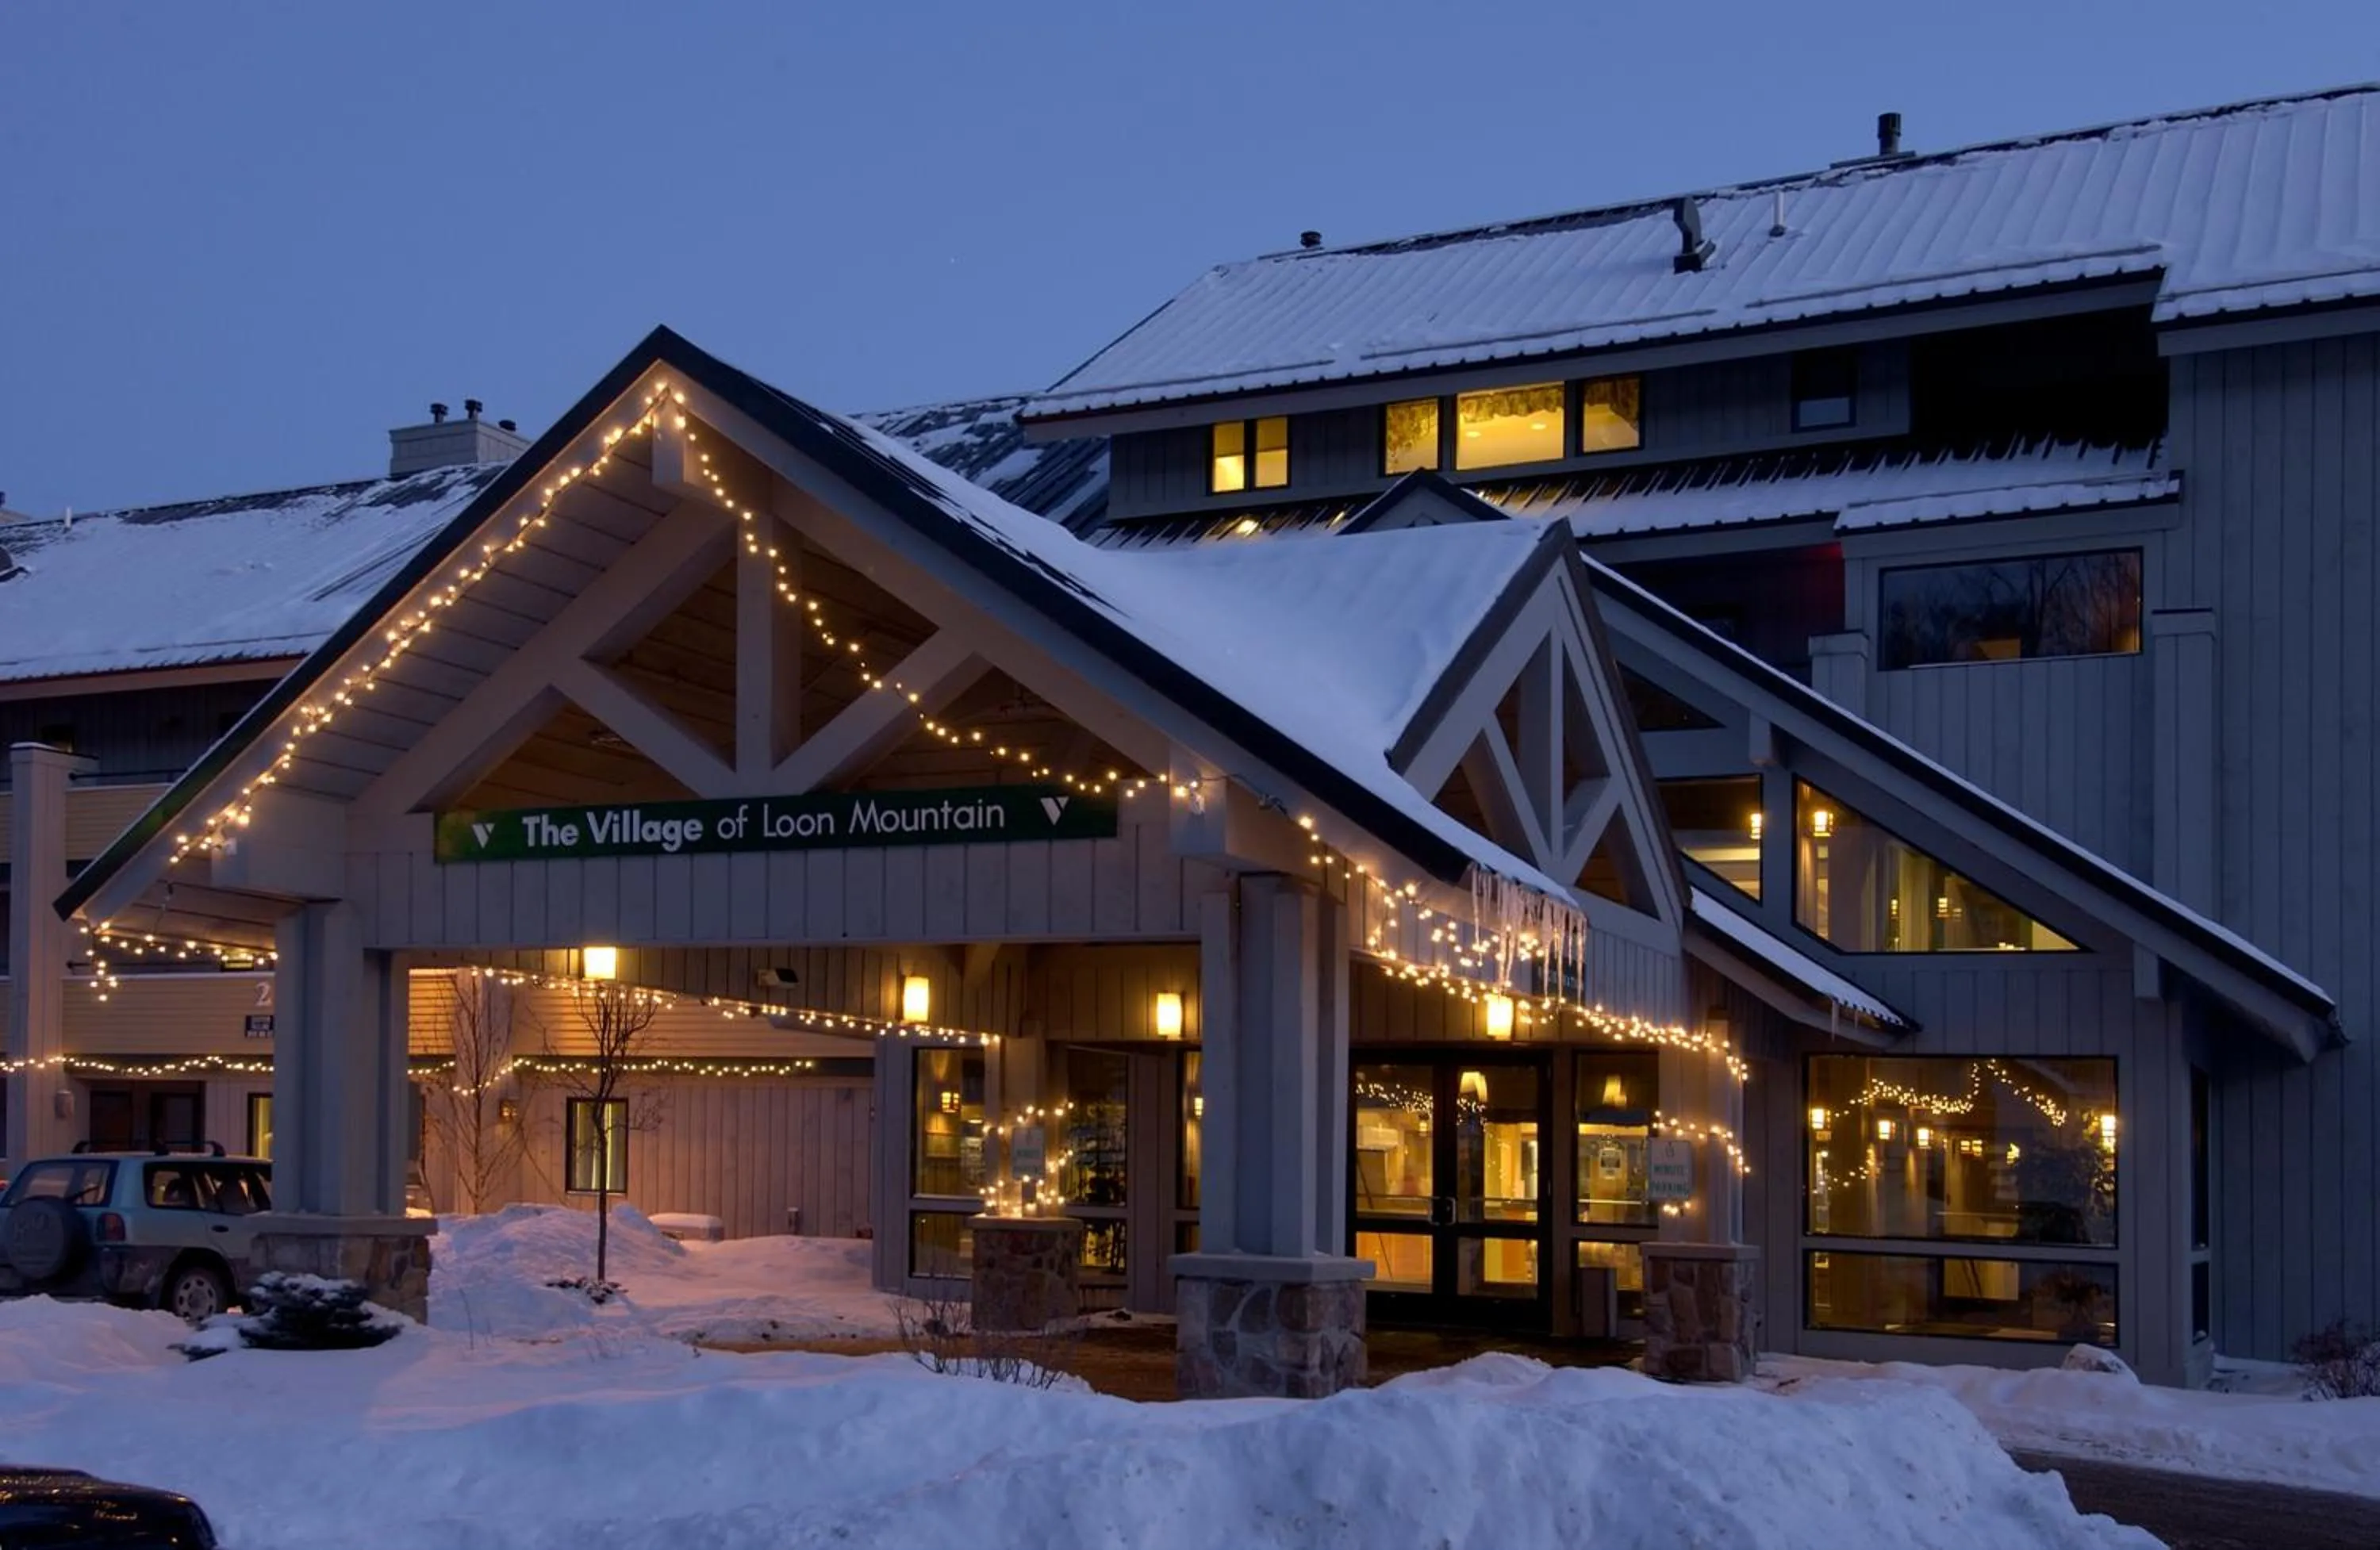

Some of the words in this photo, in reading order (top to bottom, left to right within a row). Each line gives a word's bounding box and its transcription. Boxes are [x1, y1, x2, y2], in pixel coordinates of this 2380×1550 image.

[522, 815, 578, 847] The
[585, 809, 703, 852] Village
[717, 804, 748, 839] of
[763, 803, 835, 837] Loon
[848, 800, 1004, 834] Mountain
